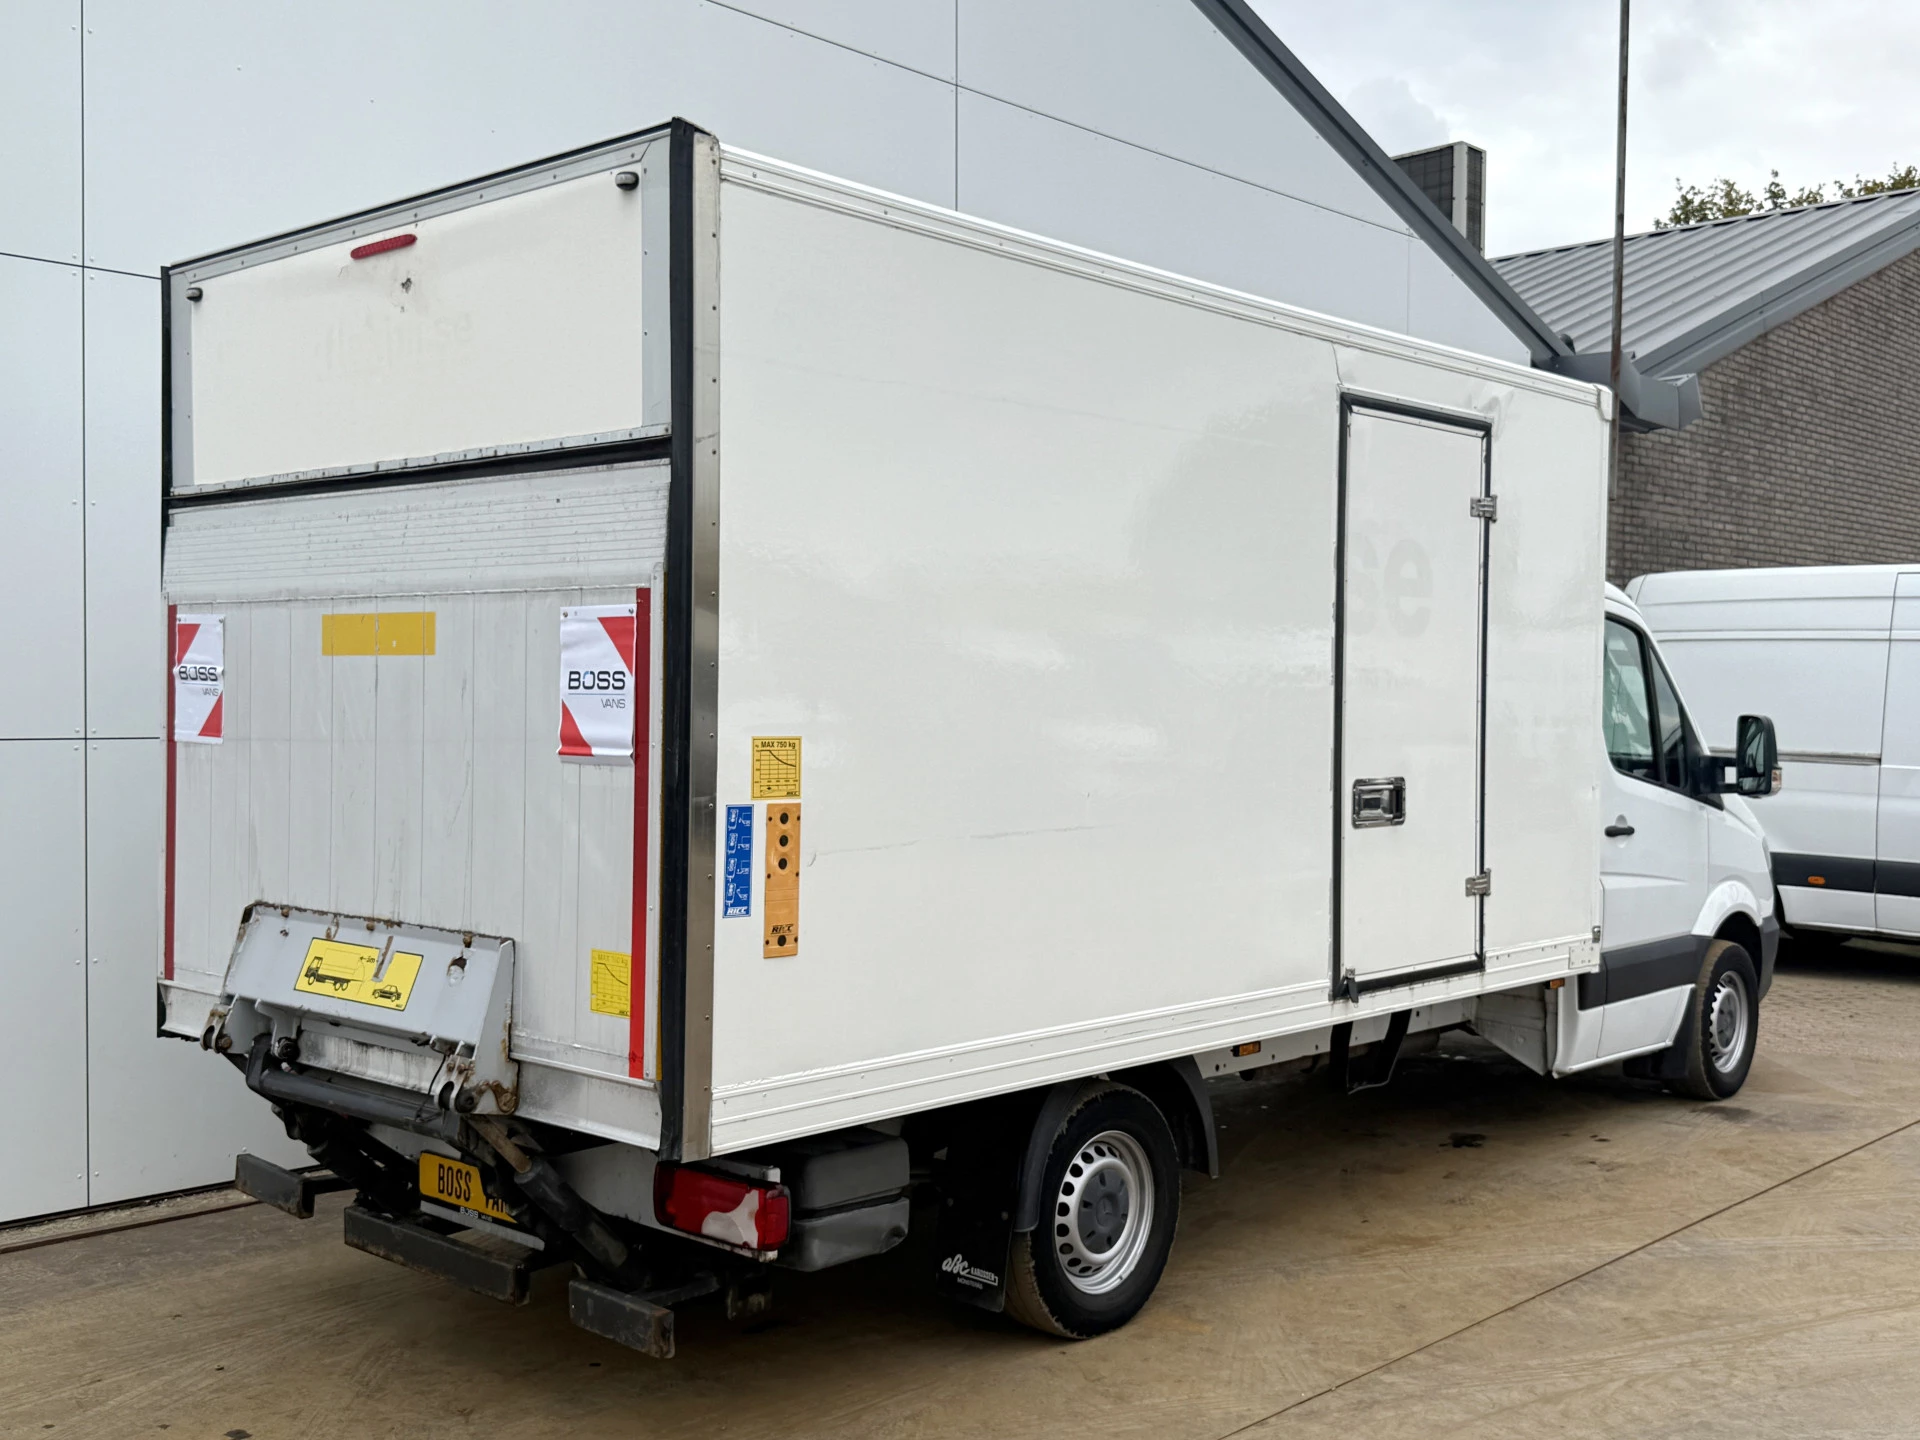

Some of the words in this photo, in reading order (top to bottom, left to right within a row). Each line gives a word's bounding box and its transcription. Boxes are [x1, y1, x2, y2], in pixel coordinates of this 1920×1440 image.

[179, 666, 218, 681] BOSS
[567, 670, 626, 690] BOSS
[202, 688, 218, 696] VANS
[600, 698, 626, 709] VANS
[788, 741, 796, 749] kg
[438, 1163, 471, 1201] BOSS
